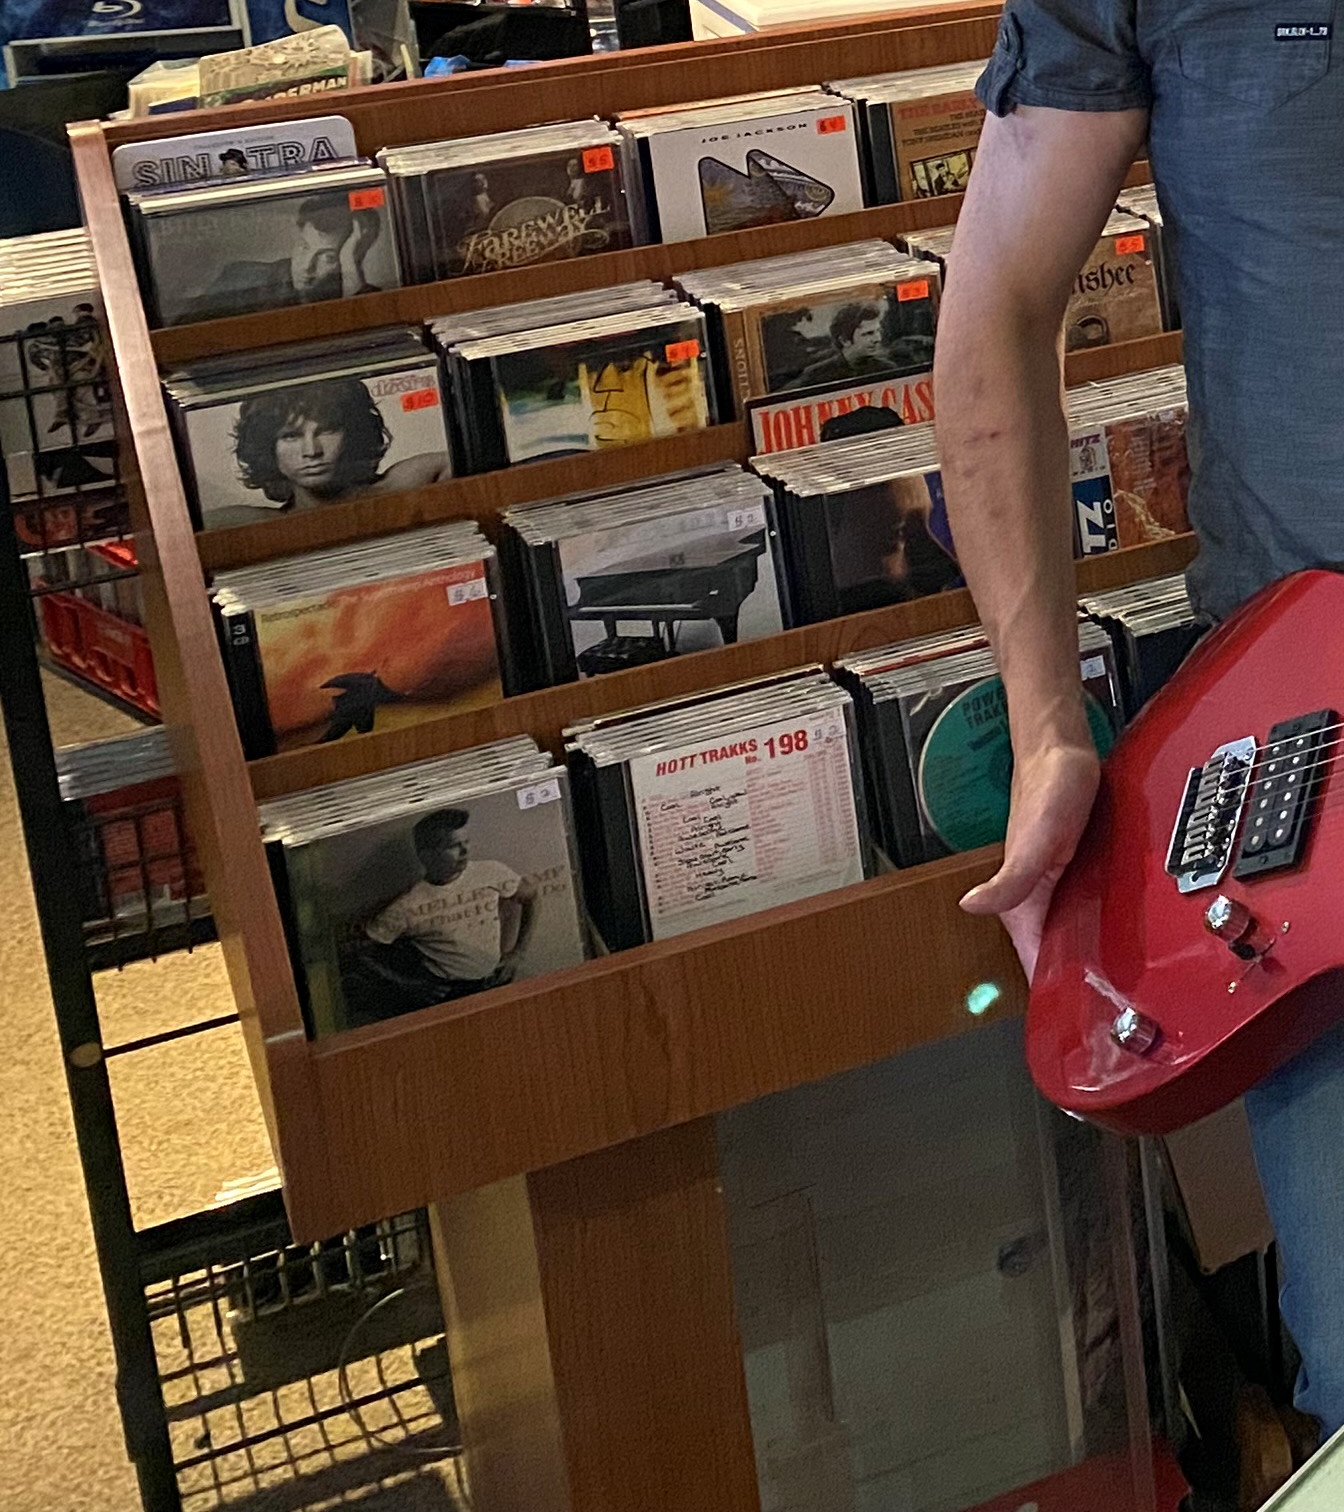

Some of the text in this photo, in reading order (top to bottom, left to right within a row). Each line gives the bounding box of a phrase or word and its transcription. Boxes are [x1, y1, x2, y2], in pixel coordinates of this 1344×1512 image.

[897, 97, 977, 119] THE EARL
[701, 121, 808, 144] JOE JACKSON
[132, 135, 341, 188] SINTRA
[1071, 261, 1136, 296] nshee
[880, 379, 935, 425] CAS
[963, 688, 1006, 717] POWE
[966, 704, 1004, 730] TRAK
[655, 729, 809, 777] HOTT TRAKKS 198
